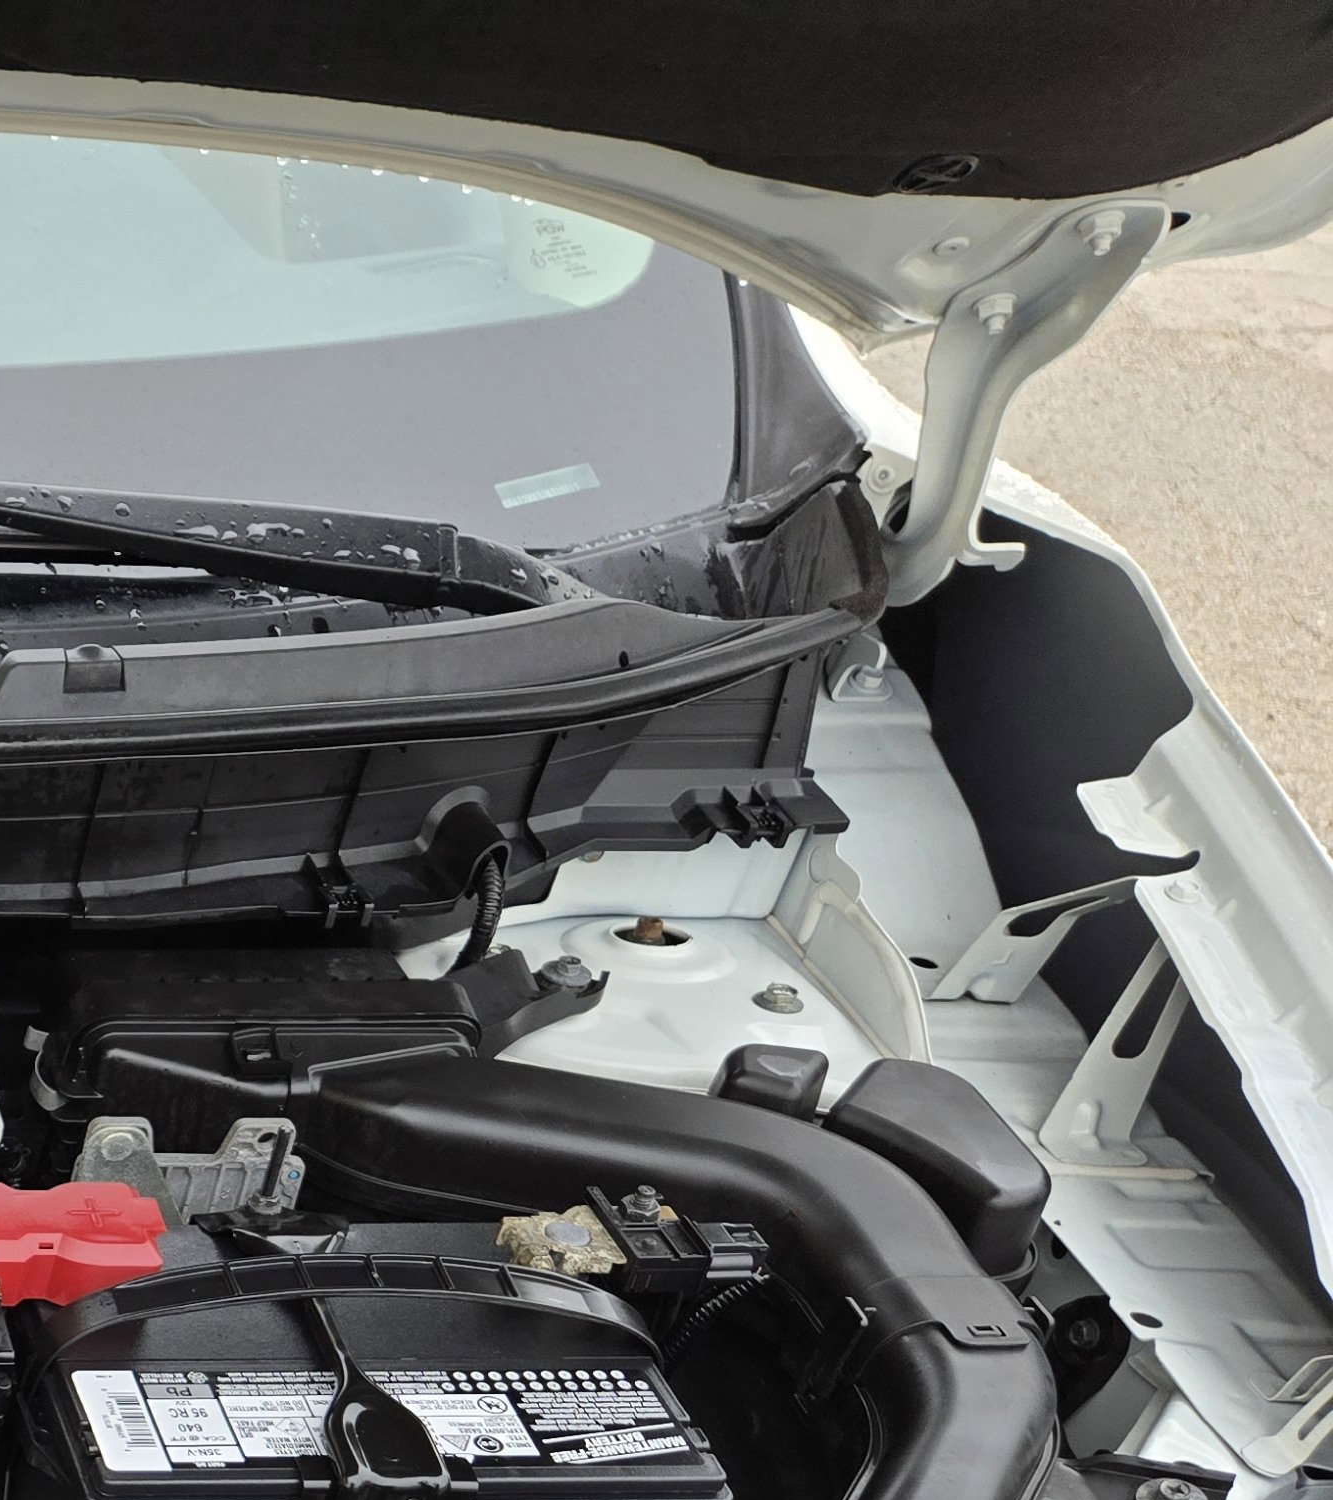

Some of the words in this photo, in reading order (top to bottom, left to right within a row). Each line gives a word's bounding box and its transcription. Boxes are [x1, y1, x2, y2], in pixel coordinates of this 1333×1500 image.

[166, 1387, 192, 1397] Pb
[168, 1408, 189, 1418] RC
[191, 1407, 208, 1418] 95
[178, 1423, 203, 1432] 640
[583, 1431, 646, 1449] BATTERY
[187, 1448, 222, 1456] 35N-V
[549, 1435, 687, 1463] MAINTENANCE-FREE
